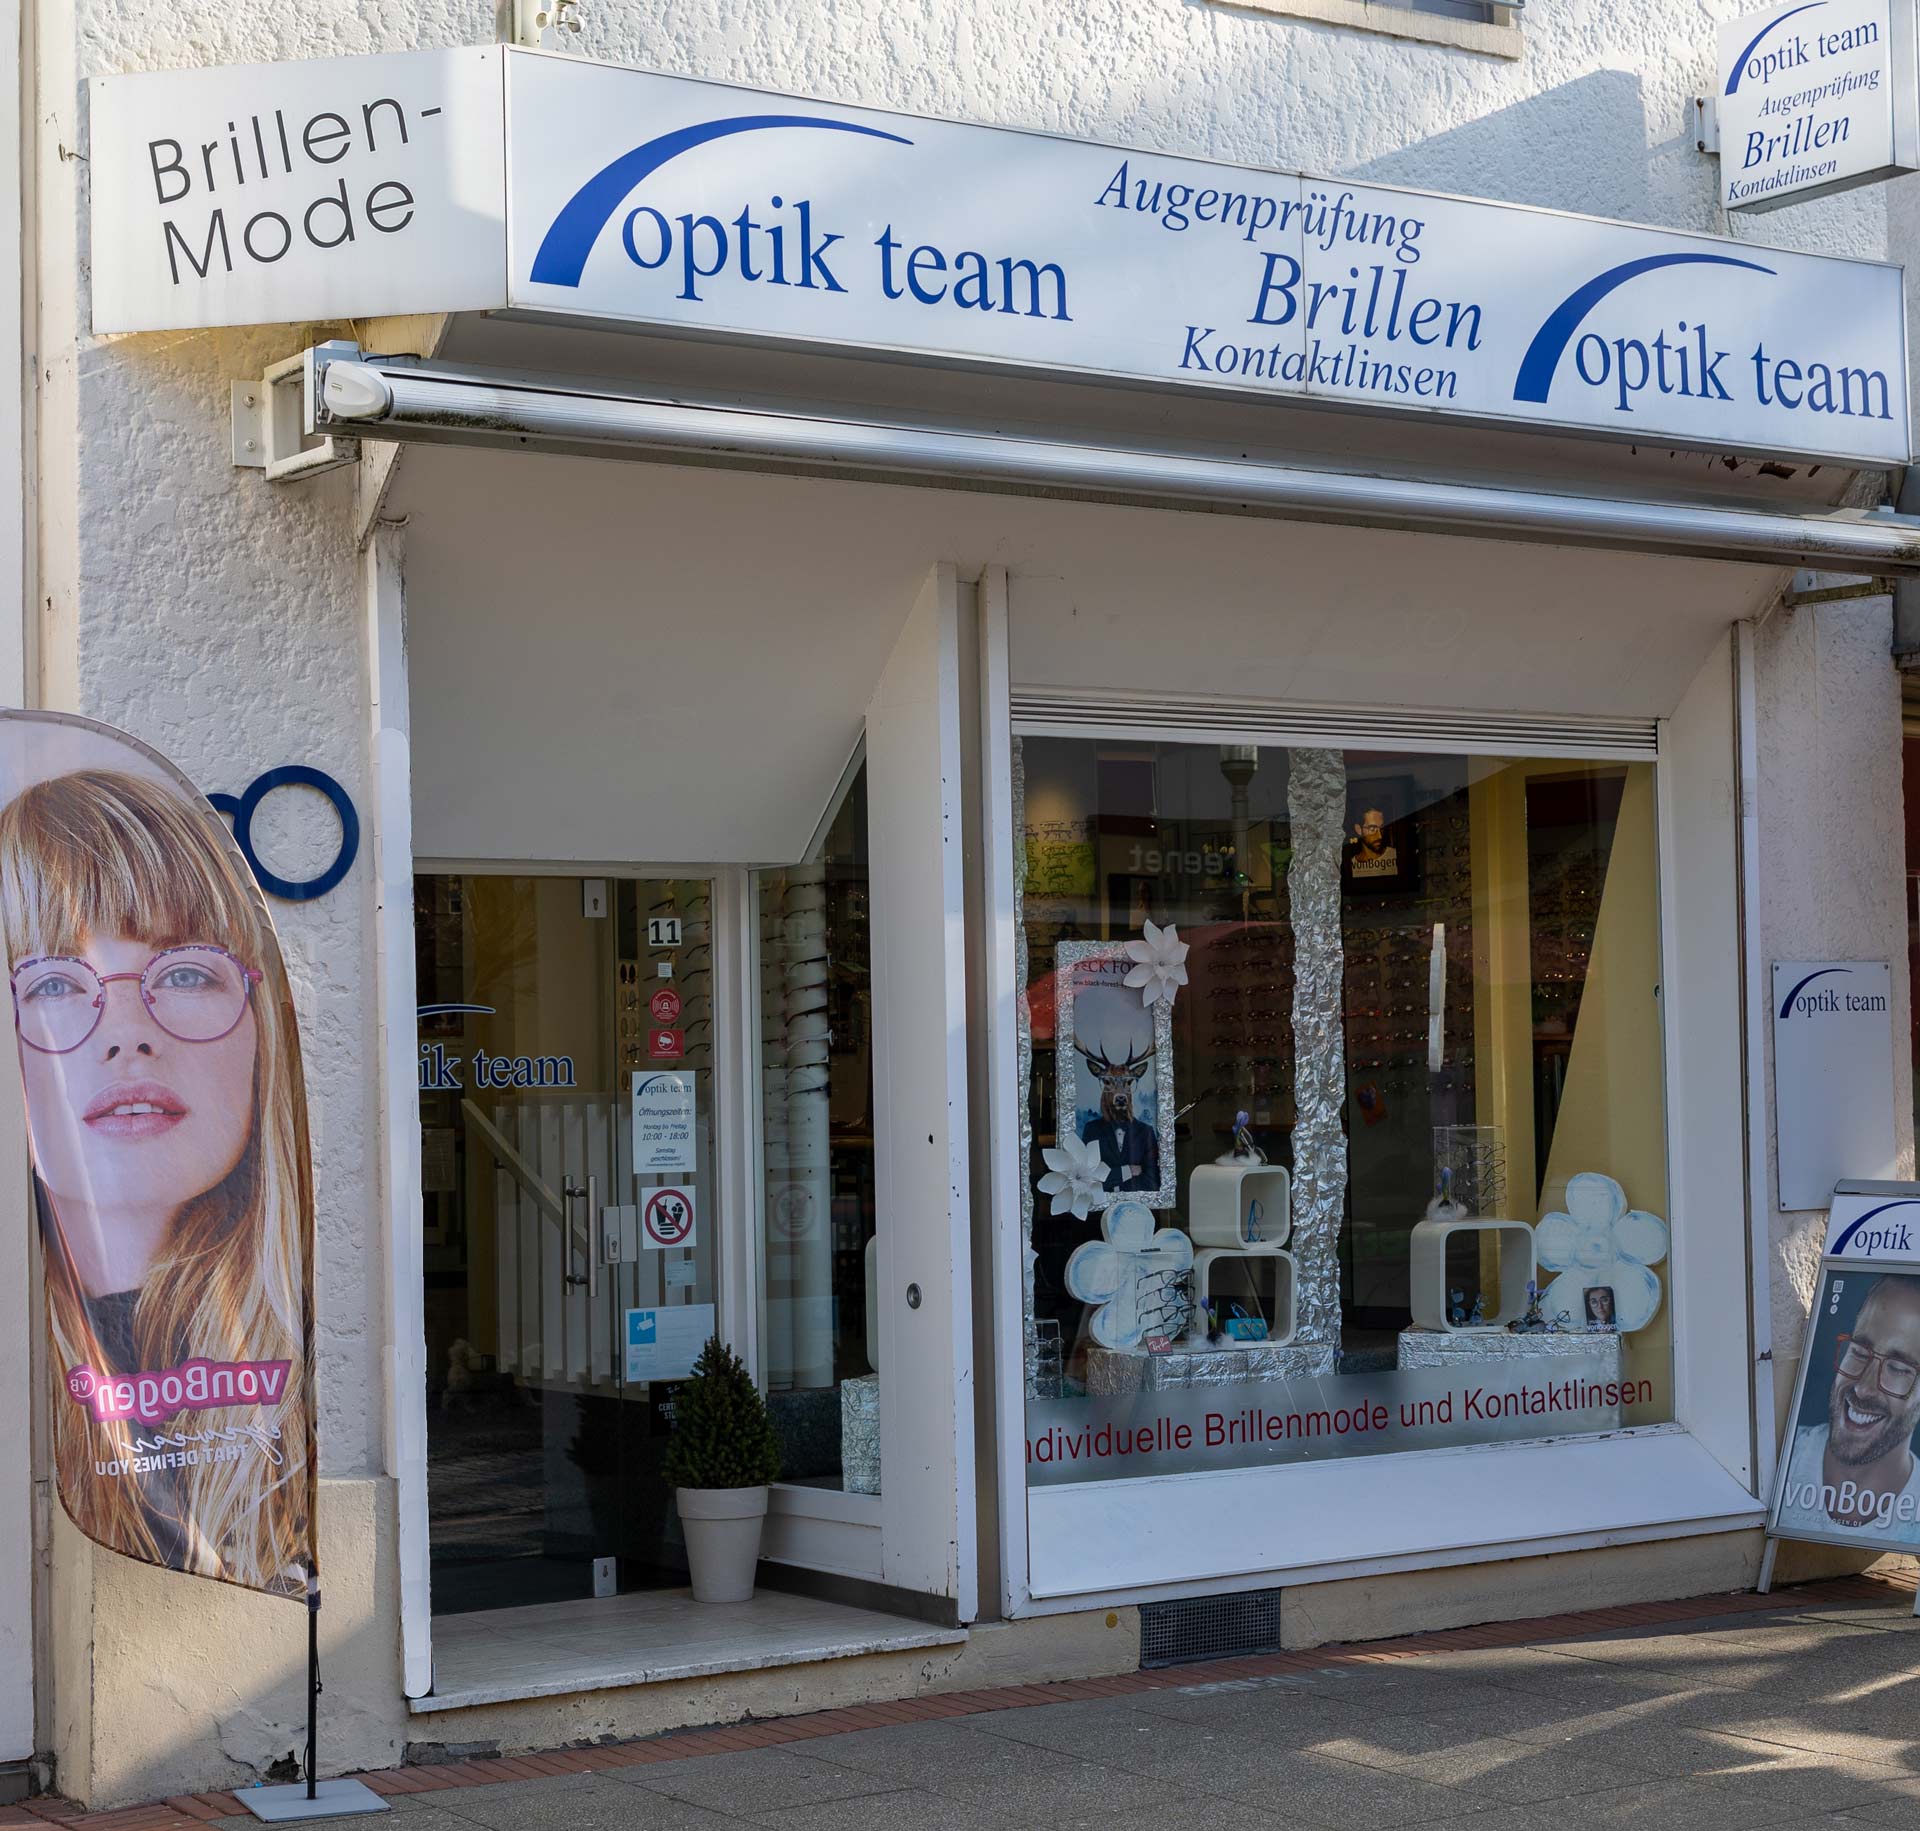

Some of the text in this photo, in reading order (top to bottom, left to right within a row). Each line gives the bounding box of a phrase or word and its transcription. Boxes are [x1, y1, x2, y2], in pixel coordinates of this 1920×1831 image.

[1747, 21, 1879, 84] optik team
[1757, 69, 1880, 117] Augenprüfung
[148, 97, 443, 205] Brillen-
[1742, 113, 1850, 169] Brillen
[1727, 159, 1837, 201] Kontaktlinsen
[162, 178, 415, 286] Mode
[1094, 160, 1425, 263] Augenprüfung
[622, 195, 1073, 322] optik team
[1246, 251, 1482, 351] Brillen
[1178, 325, 1457, 399] Kontaktlinsen
[1575, 320, 1894, 420] optik team
[650, 920, 680, 944] 11
[1796, 989, 1886, 1018] optik team
[472, 1048, 577, 1089] team
[645, 1083, 668, 1096] optik
[642, 1132, 663, 1141] 10:00
[1854, 1223, 1914, 1256] optik
[1205, 1399, 1388, 1446] Brillenmode
[1400, 1392, 1452, 1427] und
[1464, 1378, 1653, 1421] Kontaktlinsen
